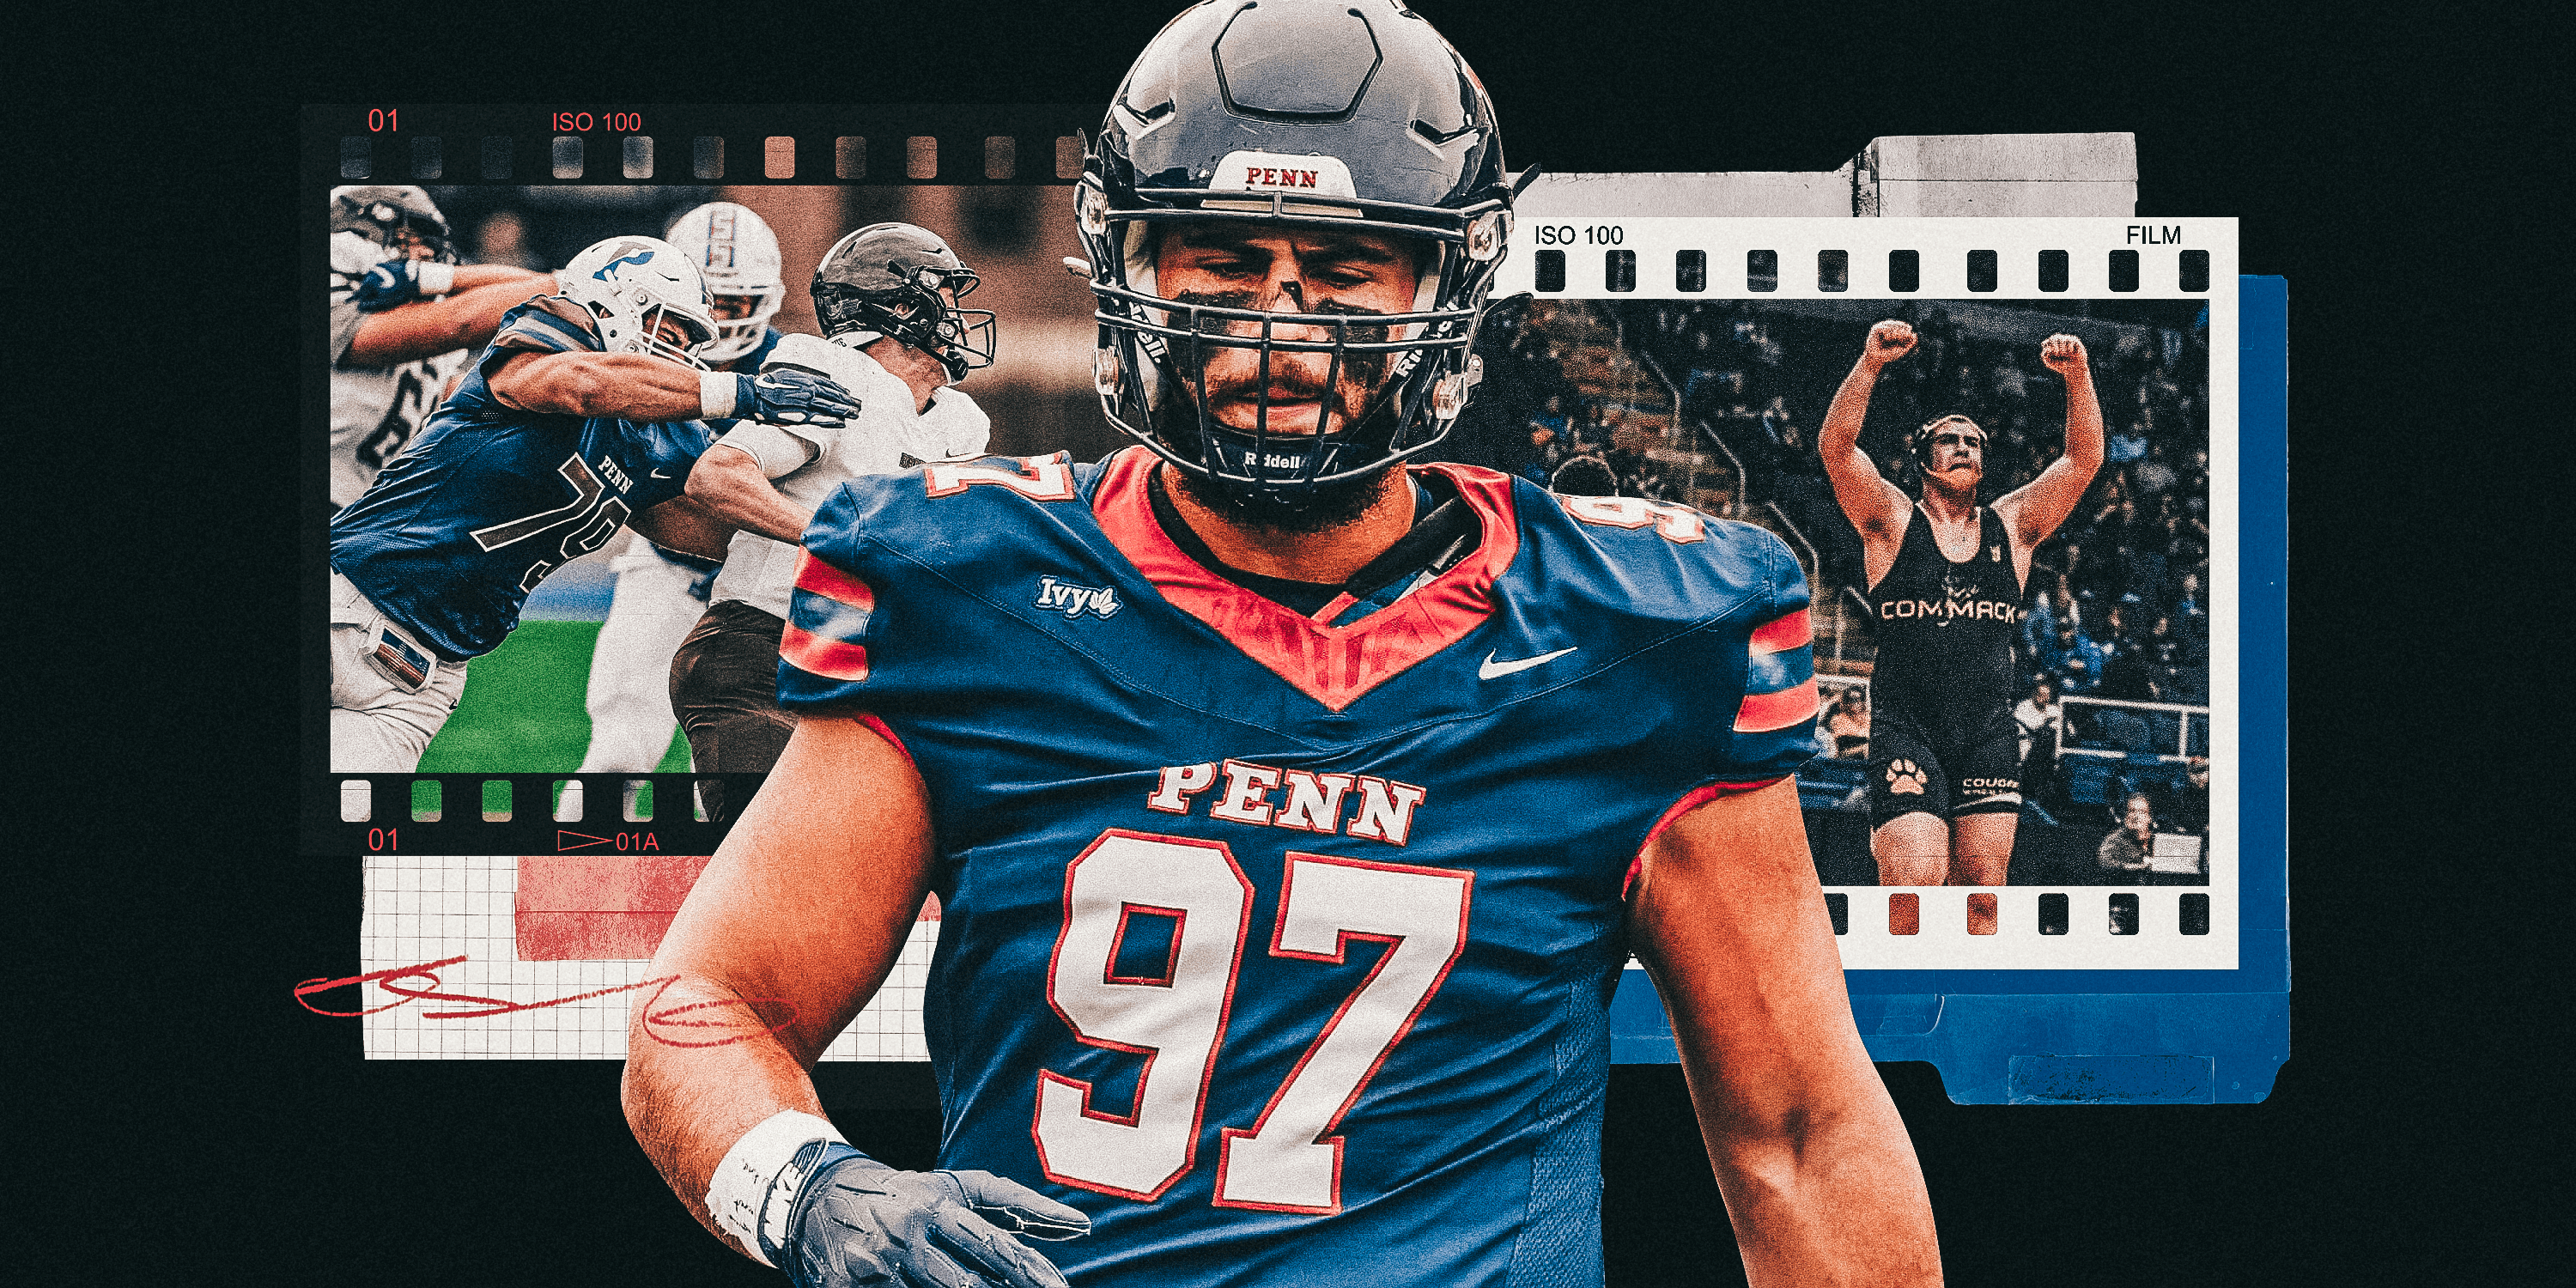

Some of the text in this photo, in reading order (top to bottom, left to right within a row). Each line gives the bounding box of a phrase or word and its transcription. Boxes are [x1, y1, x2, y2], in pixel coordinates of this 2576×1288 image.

[1246, 167, 1319, 189] PENN
[598, 454, 635, 495] PENN
[1244, 452, 1300, 469] Rddell
[1037, 578, 1092, 615] Ivy
[1881, 599, 2016, 624] COMMACK
[1147, 757, 1427, 847] PENN
[1031, 827, 1476, 1217] 97
